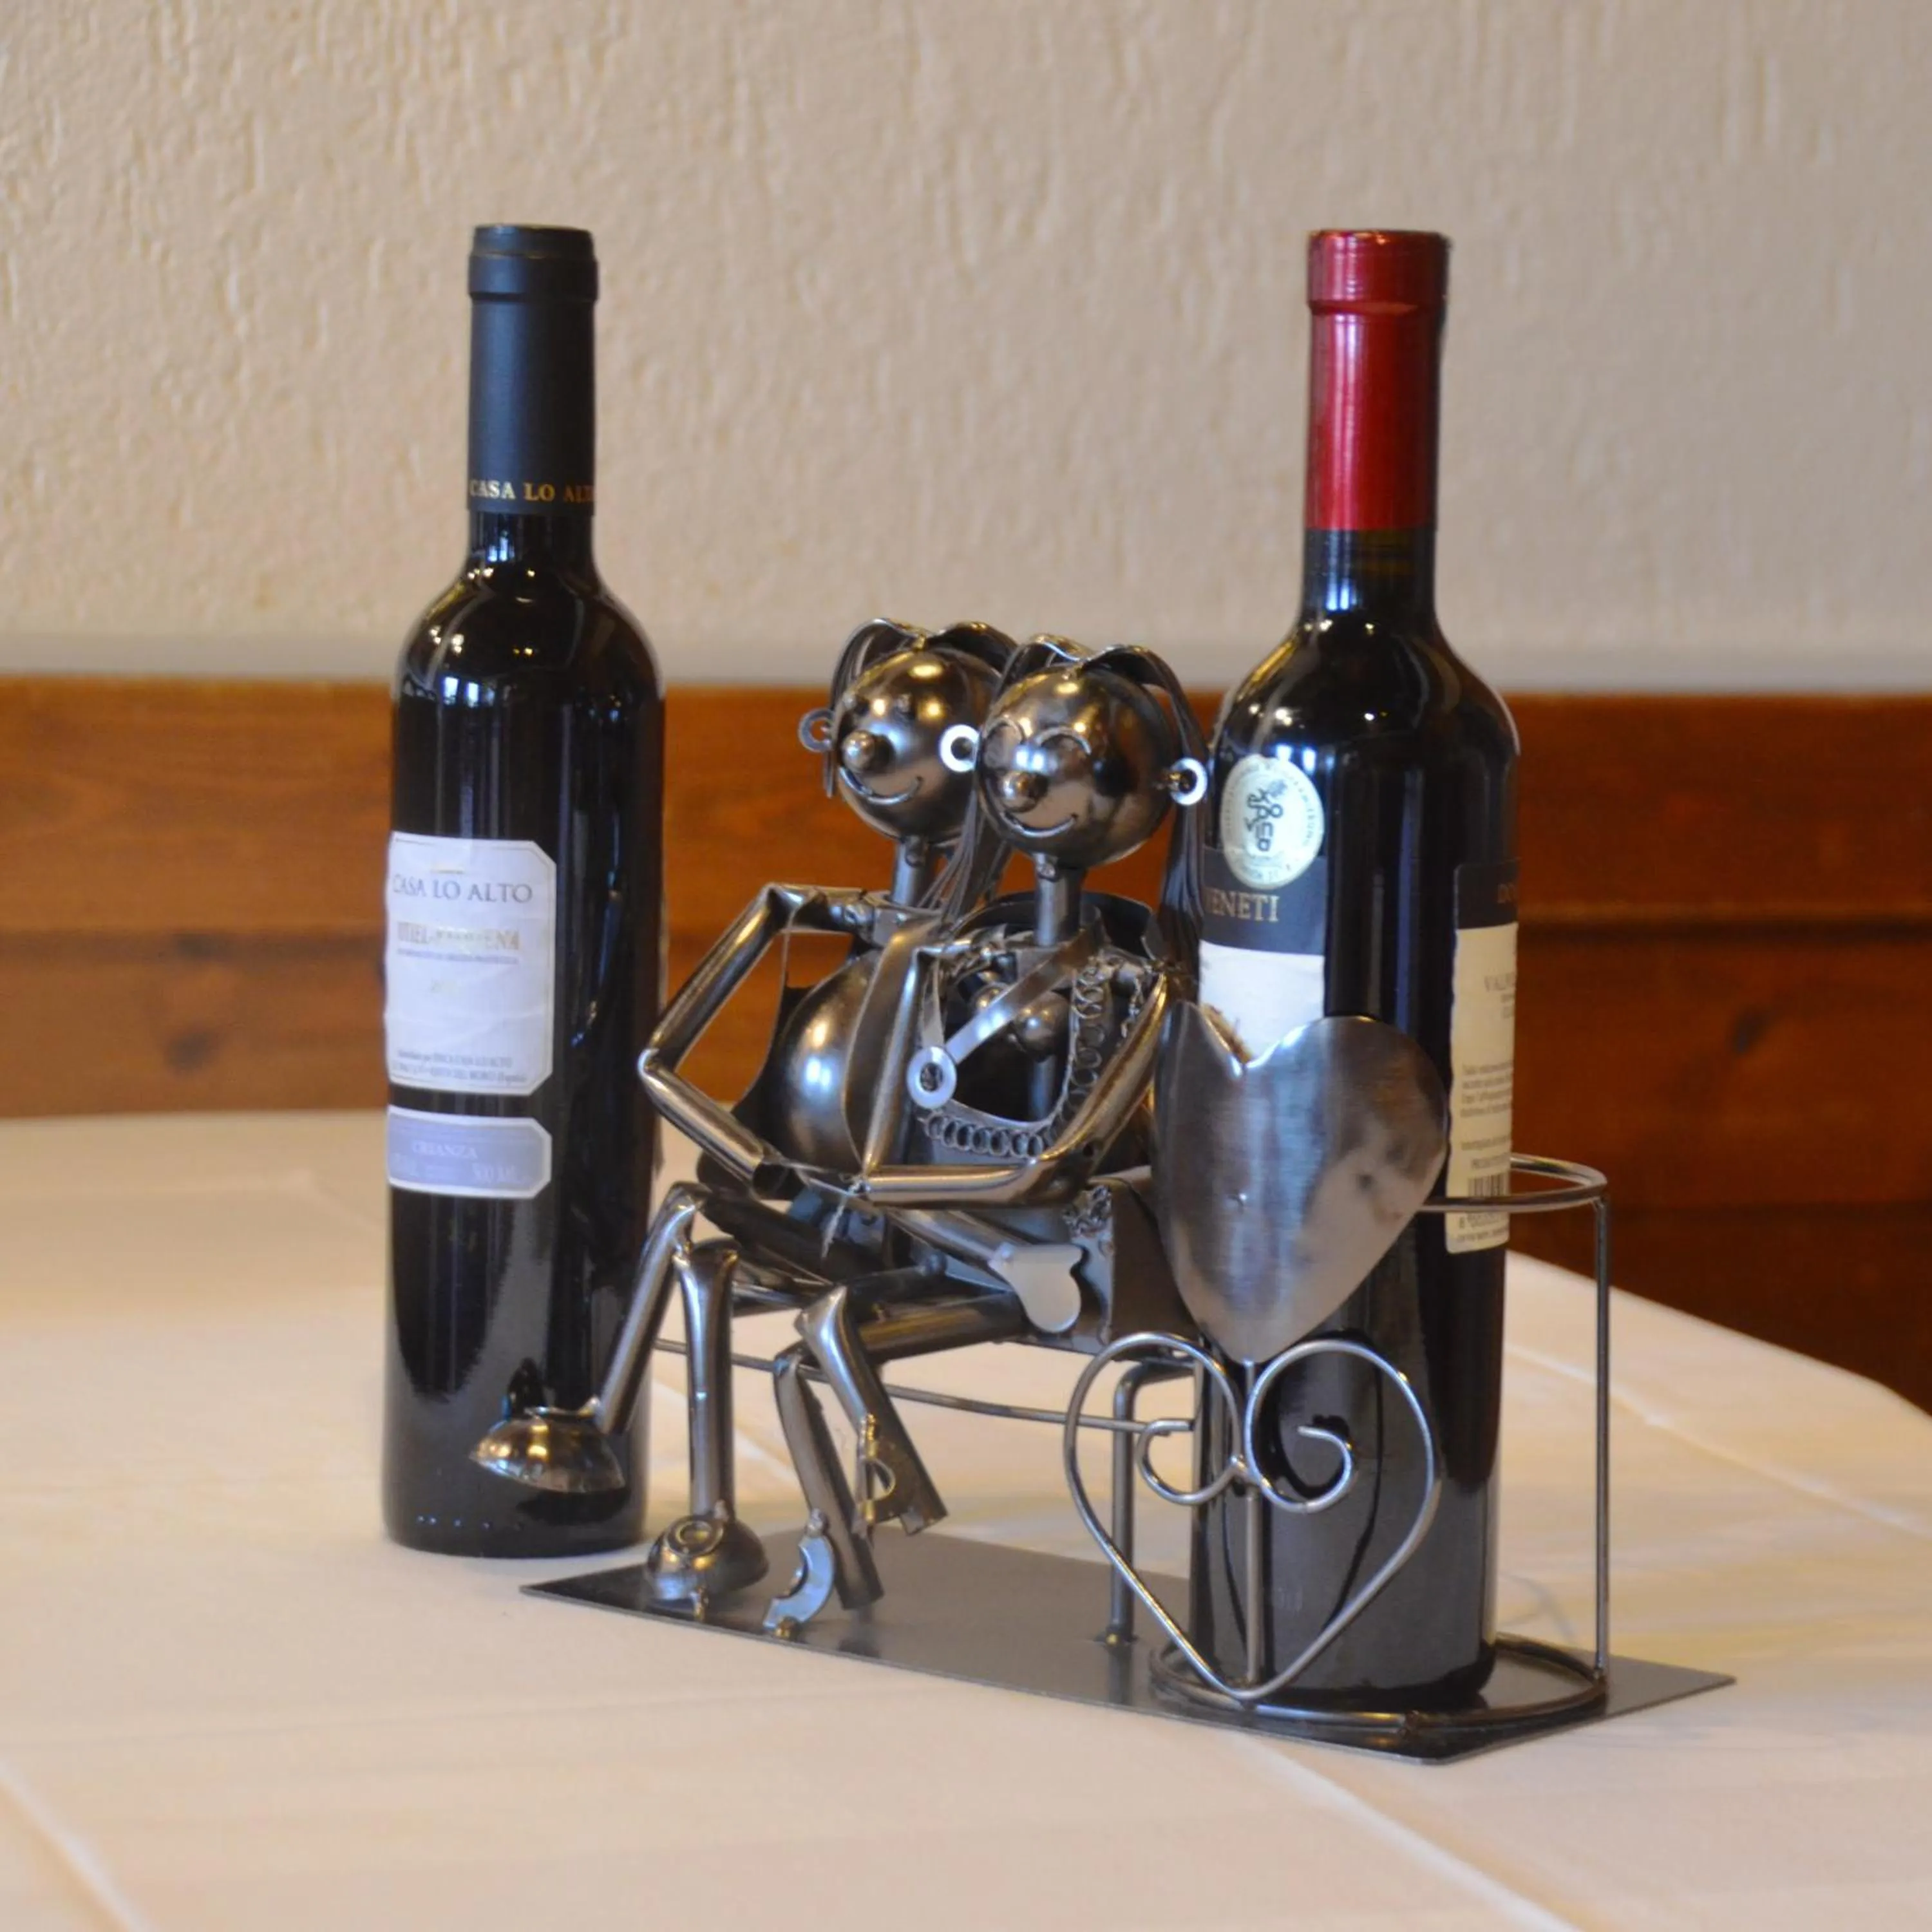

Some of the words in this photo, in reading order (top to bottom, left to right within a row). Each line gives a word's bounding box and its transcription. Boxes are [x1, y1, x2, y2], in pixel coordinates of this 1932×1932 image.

[470, 478, 516, 500] CASA
[524, 482, 555, 502] LO
[392, 872, 428, 897] CASA
[433, 878, 461, 900] LO
[468, 882, 533, 904] ALTO
